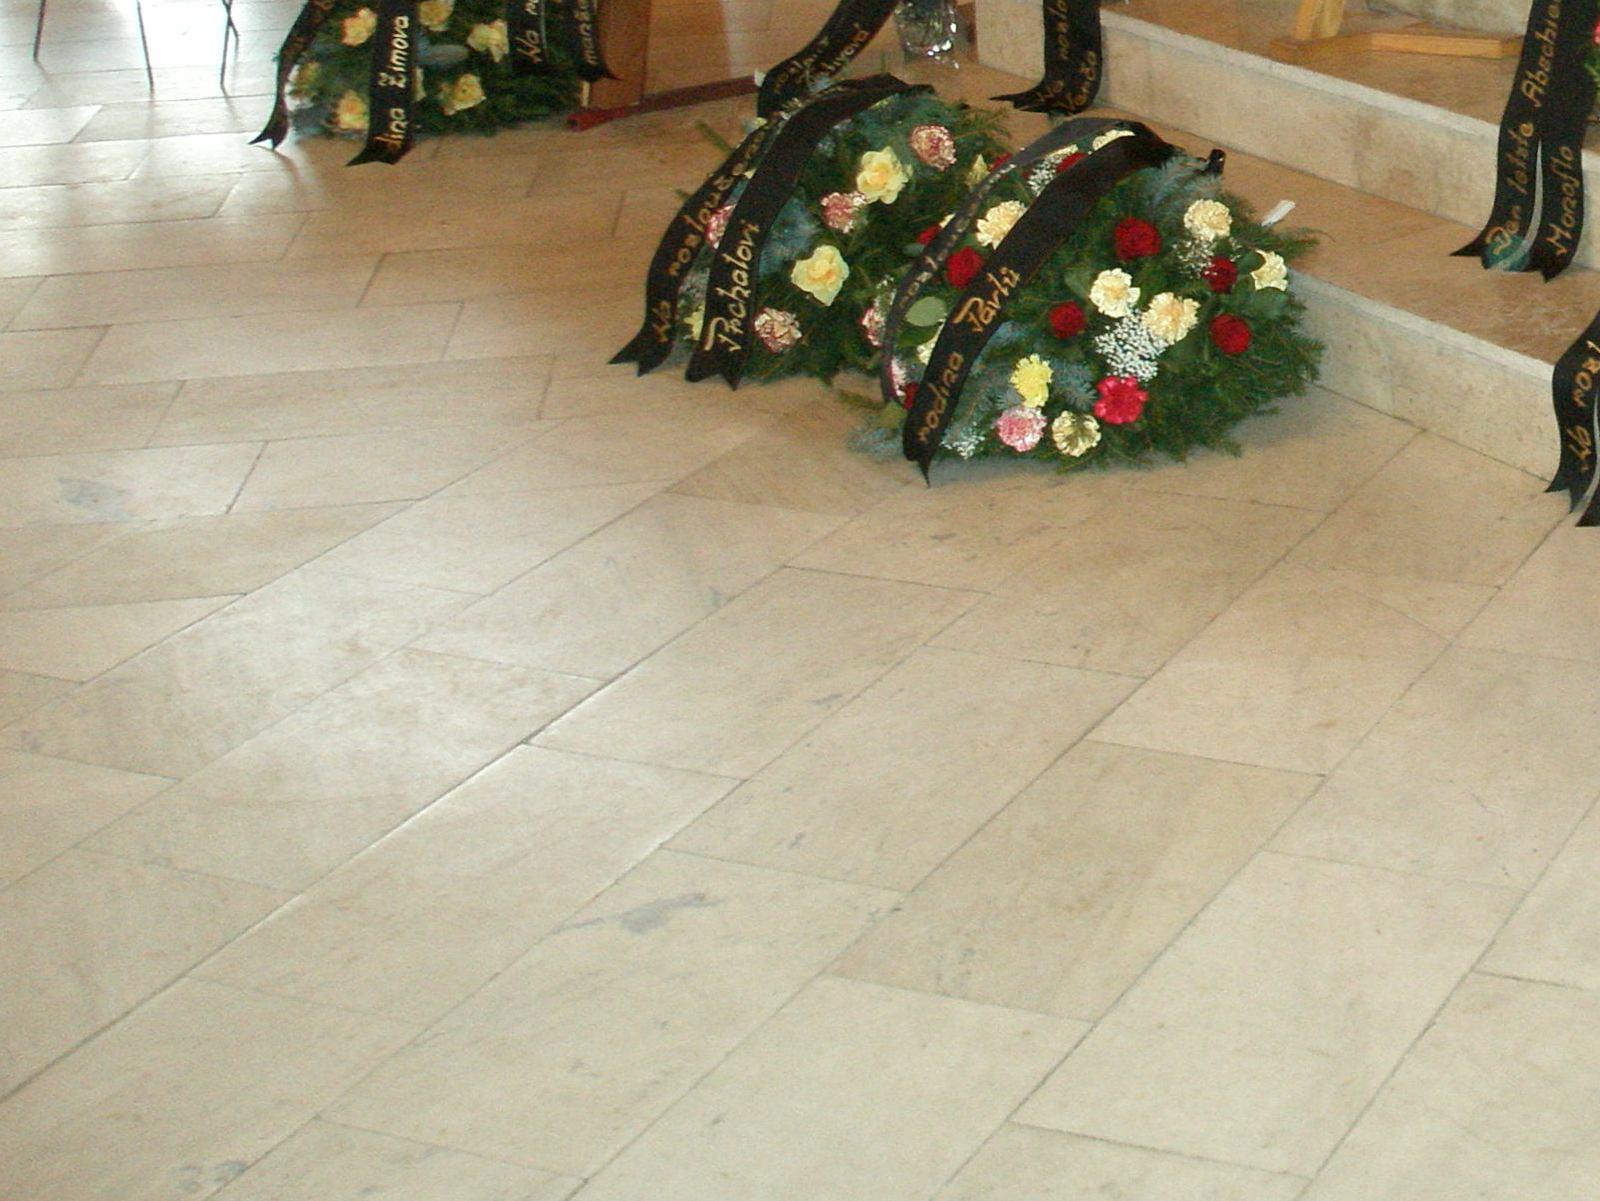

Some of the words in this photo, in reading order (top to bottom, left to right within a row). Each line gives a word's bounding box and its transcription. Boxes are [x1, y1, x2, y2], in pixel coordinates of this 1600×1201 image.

[514, 29, 543, 65] Na
[373, 107, 408, 152] dina
[651, 299, 672, 344] Na
[916, 351, 965, 443] rodina
[1566, 424, 1592, 474] Na
